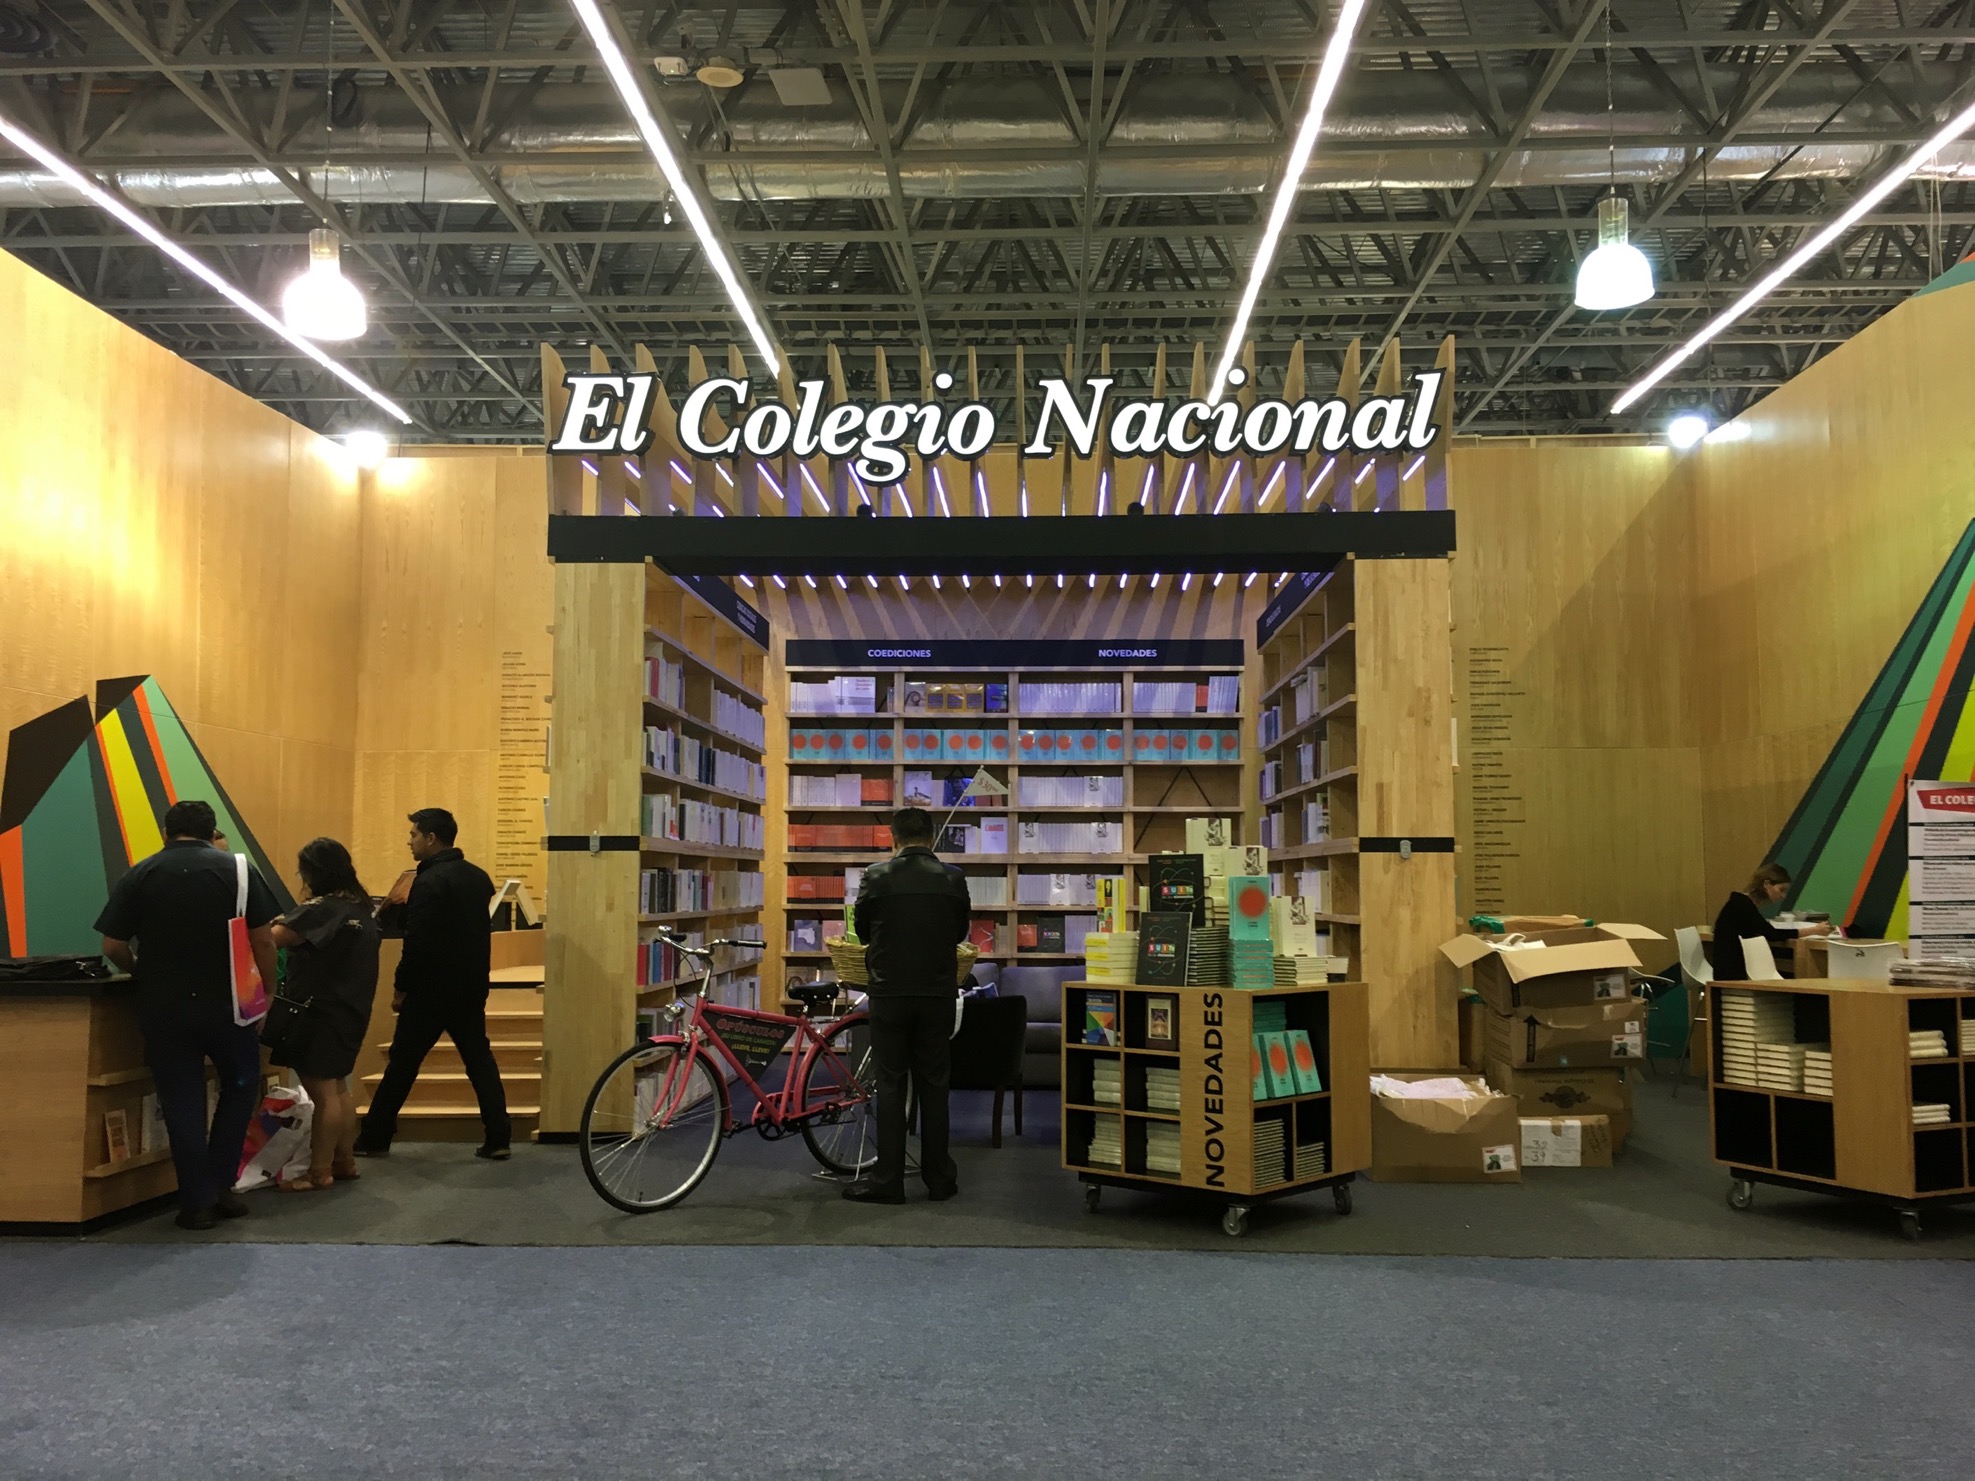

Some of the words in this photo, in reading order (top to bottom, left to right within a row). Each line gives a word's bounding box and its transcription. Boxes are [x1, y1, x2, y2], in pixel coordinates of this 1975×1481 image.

[550, 374, 657, 453] El
[679, 372, 996, 484] Colegio
[1023, 369, 1444, 457] Nacional
[867, 648, 932, 658] COEDICIONES
[1098, 648, 1158, 658] NOVEDADES
[1929, 795, 1944, 805] EL
[1944, 795, 1975, 805] COLE
[1203, 992, 1226, 1188] NOVEDADES
